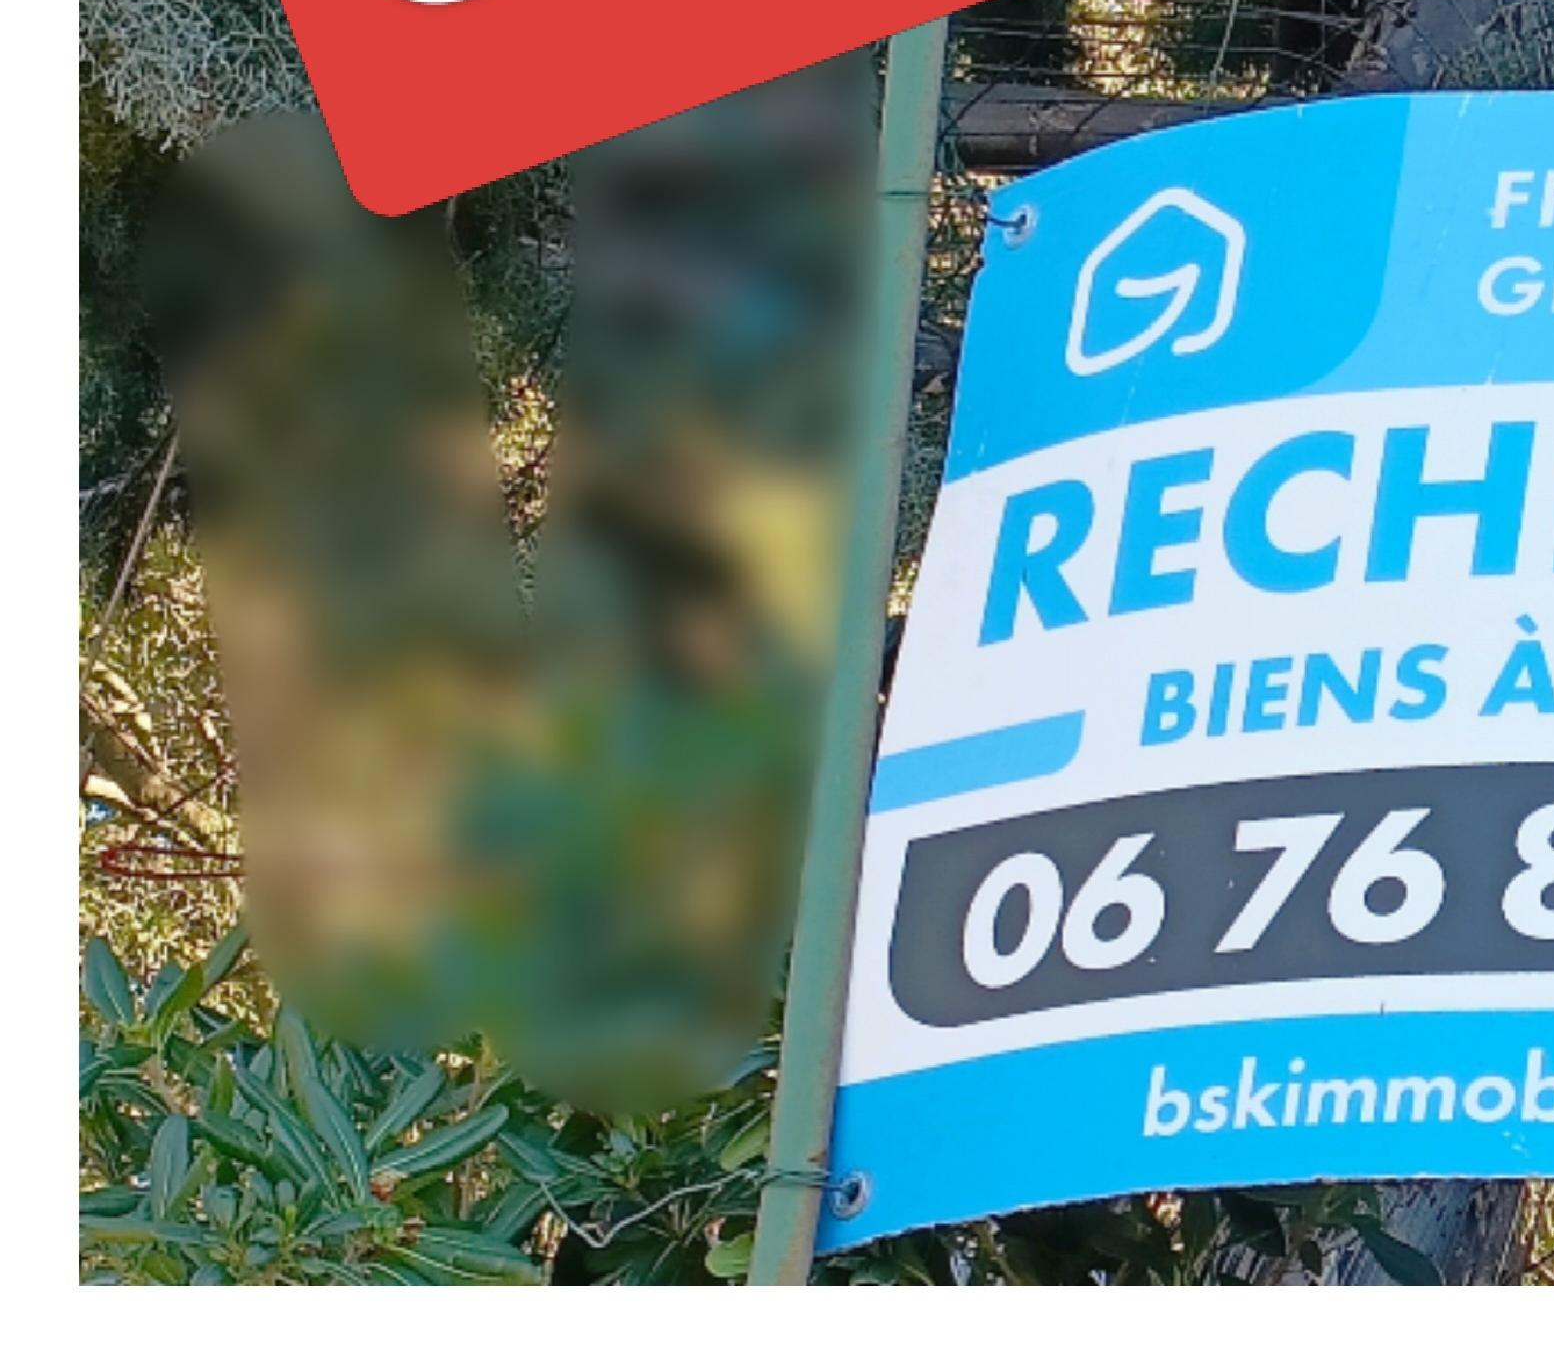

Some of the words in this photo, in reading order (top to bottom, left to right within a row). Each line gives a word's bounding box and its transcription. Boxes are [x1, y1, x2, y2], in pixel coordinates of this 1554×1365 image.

[1137, 639, 1447, 748] BIENS
[960, 833, 1166, 989] 06
[1211, 804, 1448, 953] 76
